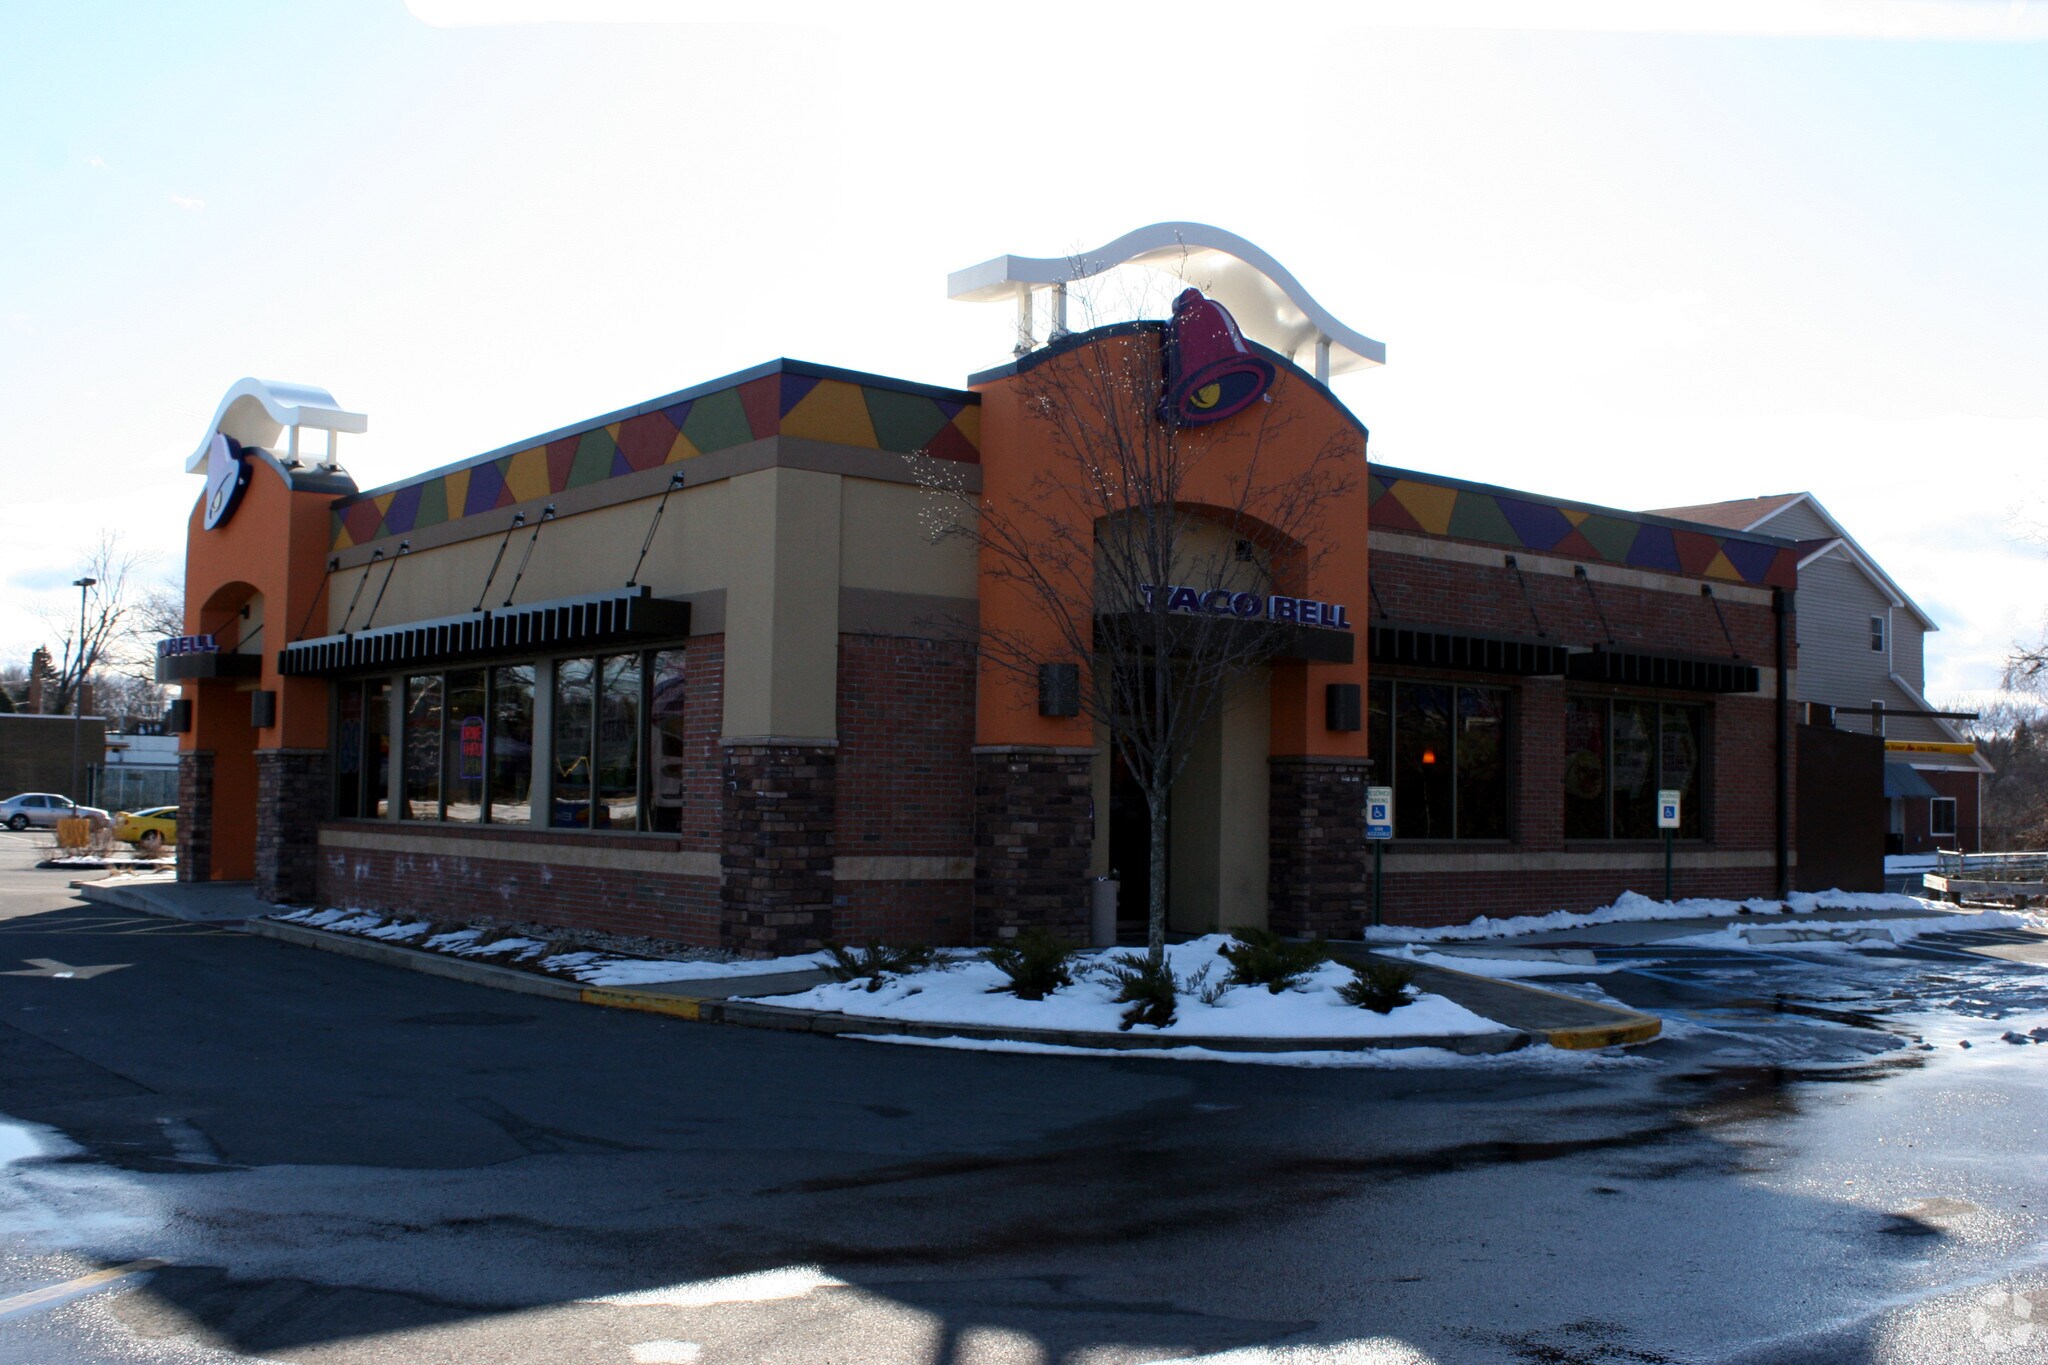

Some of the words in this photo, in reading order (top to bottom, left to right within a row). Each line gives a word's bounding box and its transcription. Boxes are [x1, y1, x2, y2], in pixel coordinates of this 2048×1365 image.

[1140, 583, 1263, 617] TACO
[1267, 595, 1350, 630] BELL
[167, 634, 221, 655] BELL
